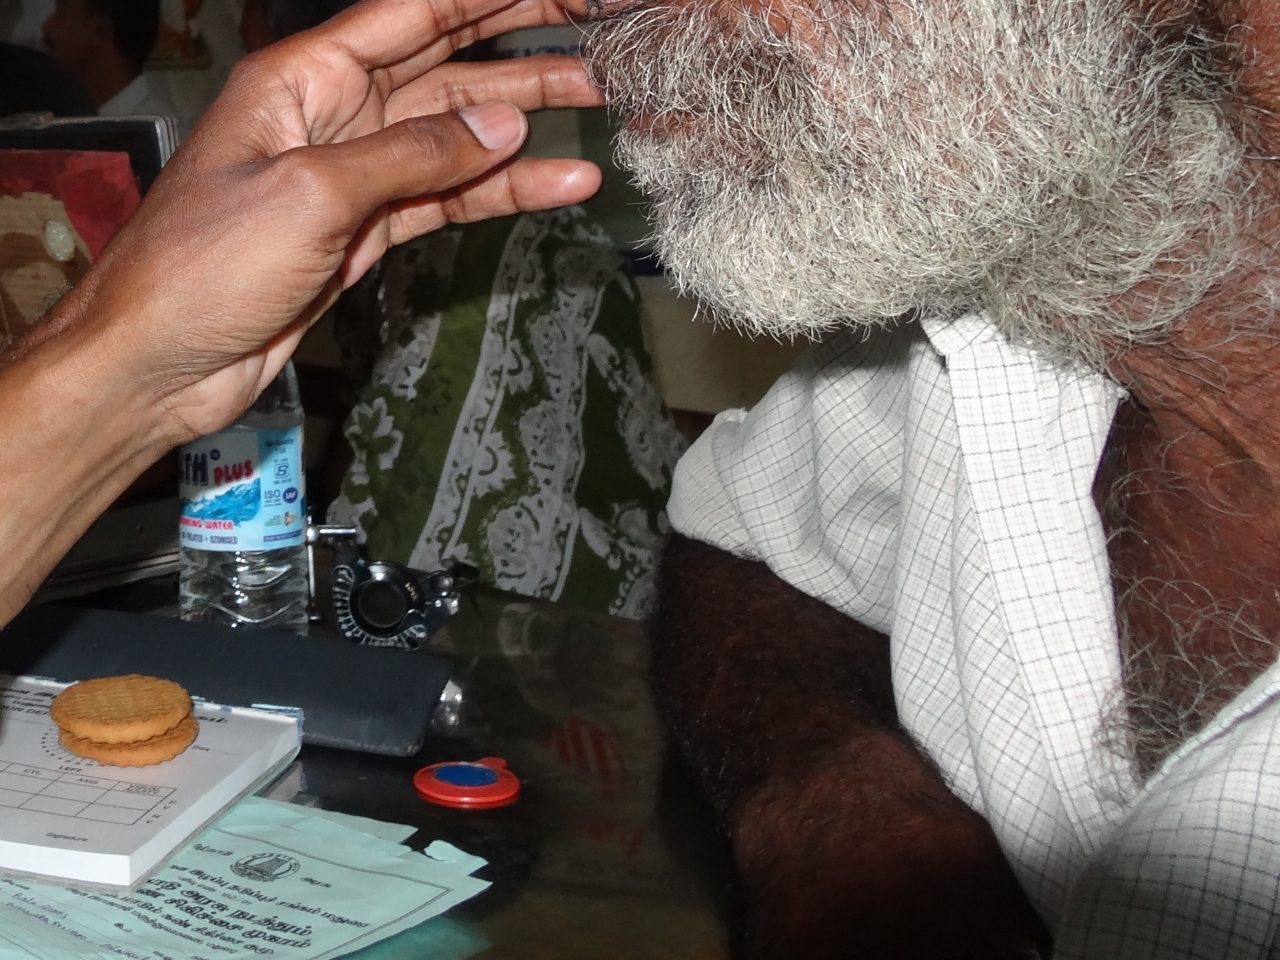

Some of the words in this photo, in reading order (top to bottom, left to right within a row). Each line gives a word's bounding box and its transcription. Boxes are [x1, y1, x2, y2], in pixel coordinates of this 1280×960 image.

[214, 460, 254, 486] PLUS
[264, 490, 281, 500] ISO
[205, 519, 234, 530] WATER
[23, 768, 42, 776] CYL
[58, 765, 82, 773] LEFT
[45, 831, 89, 842] Signature
[164, 897, 244, 932] சிகிச்சை
[241, 928, 312, 949] முகாம்
